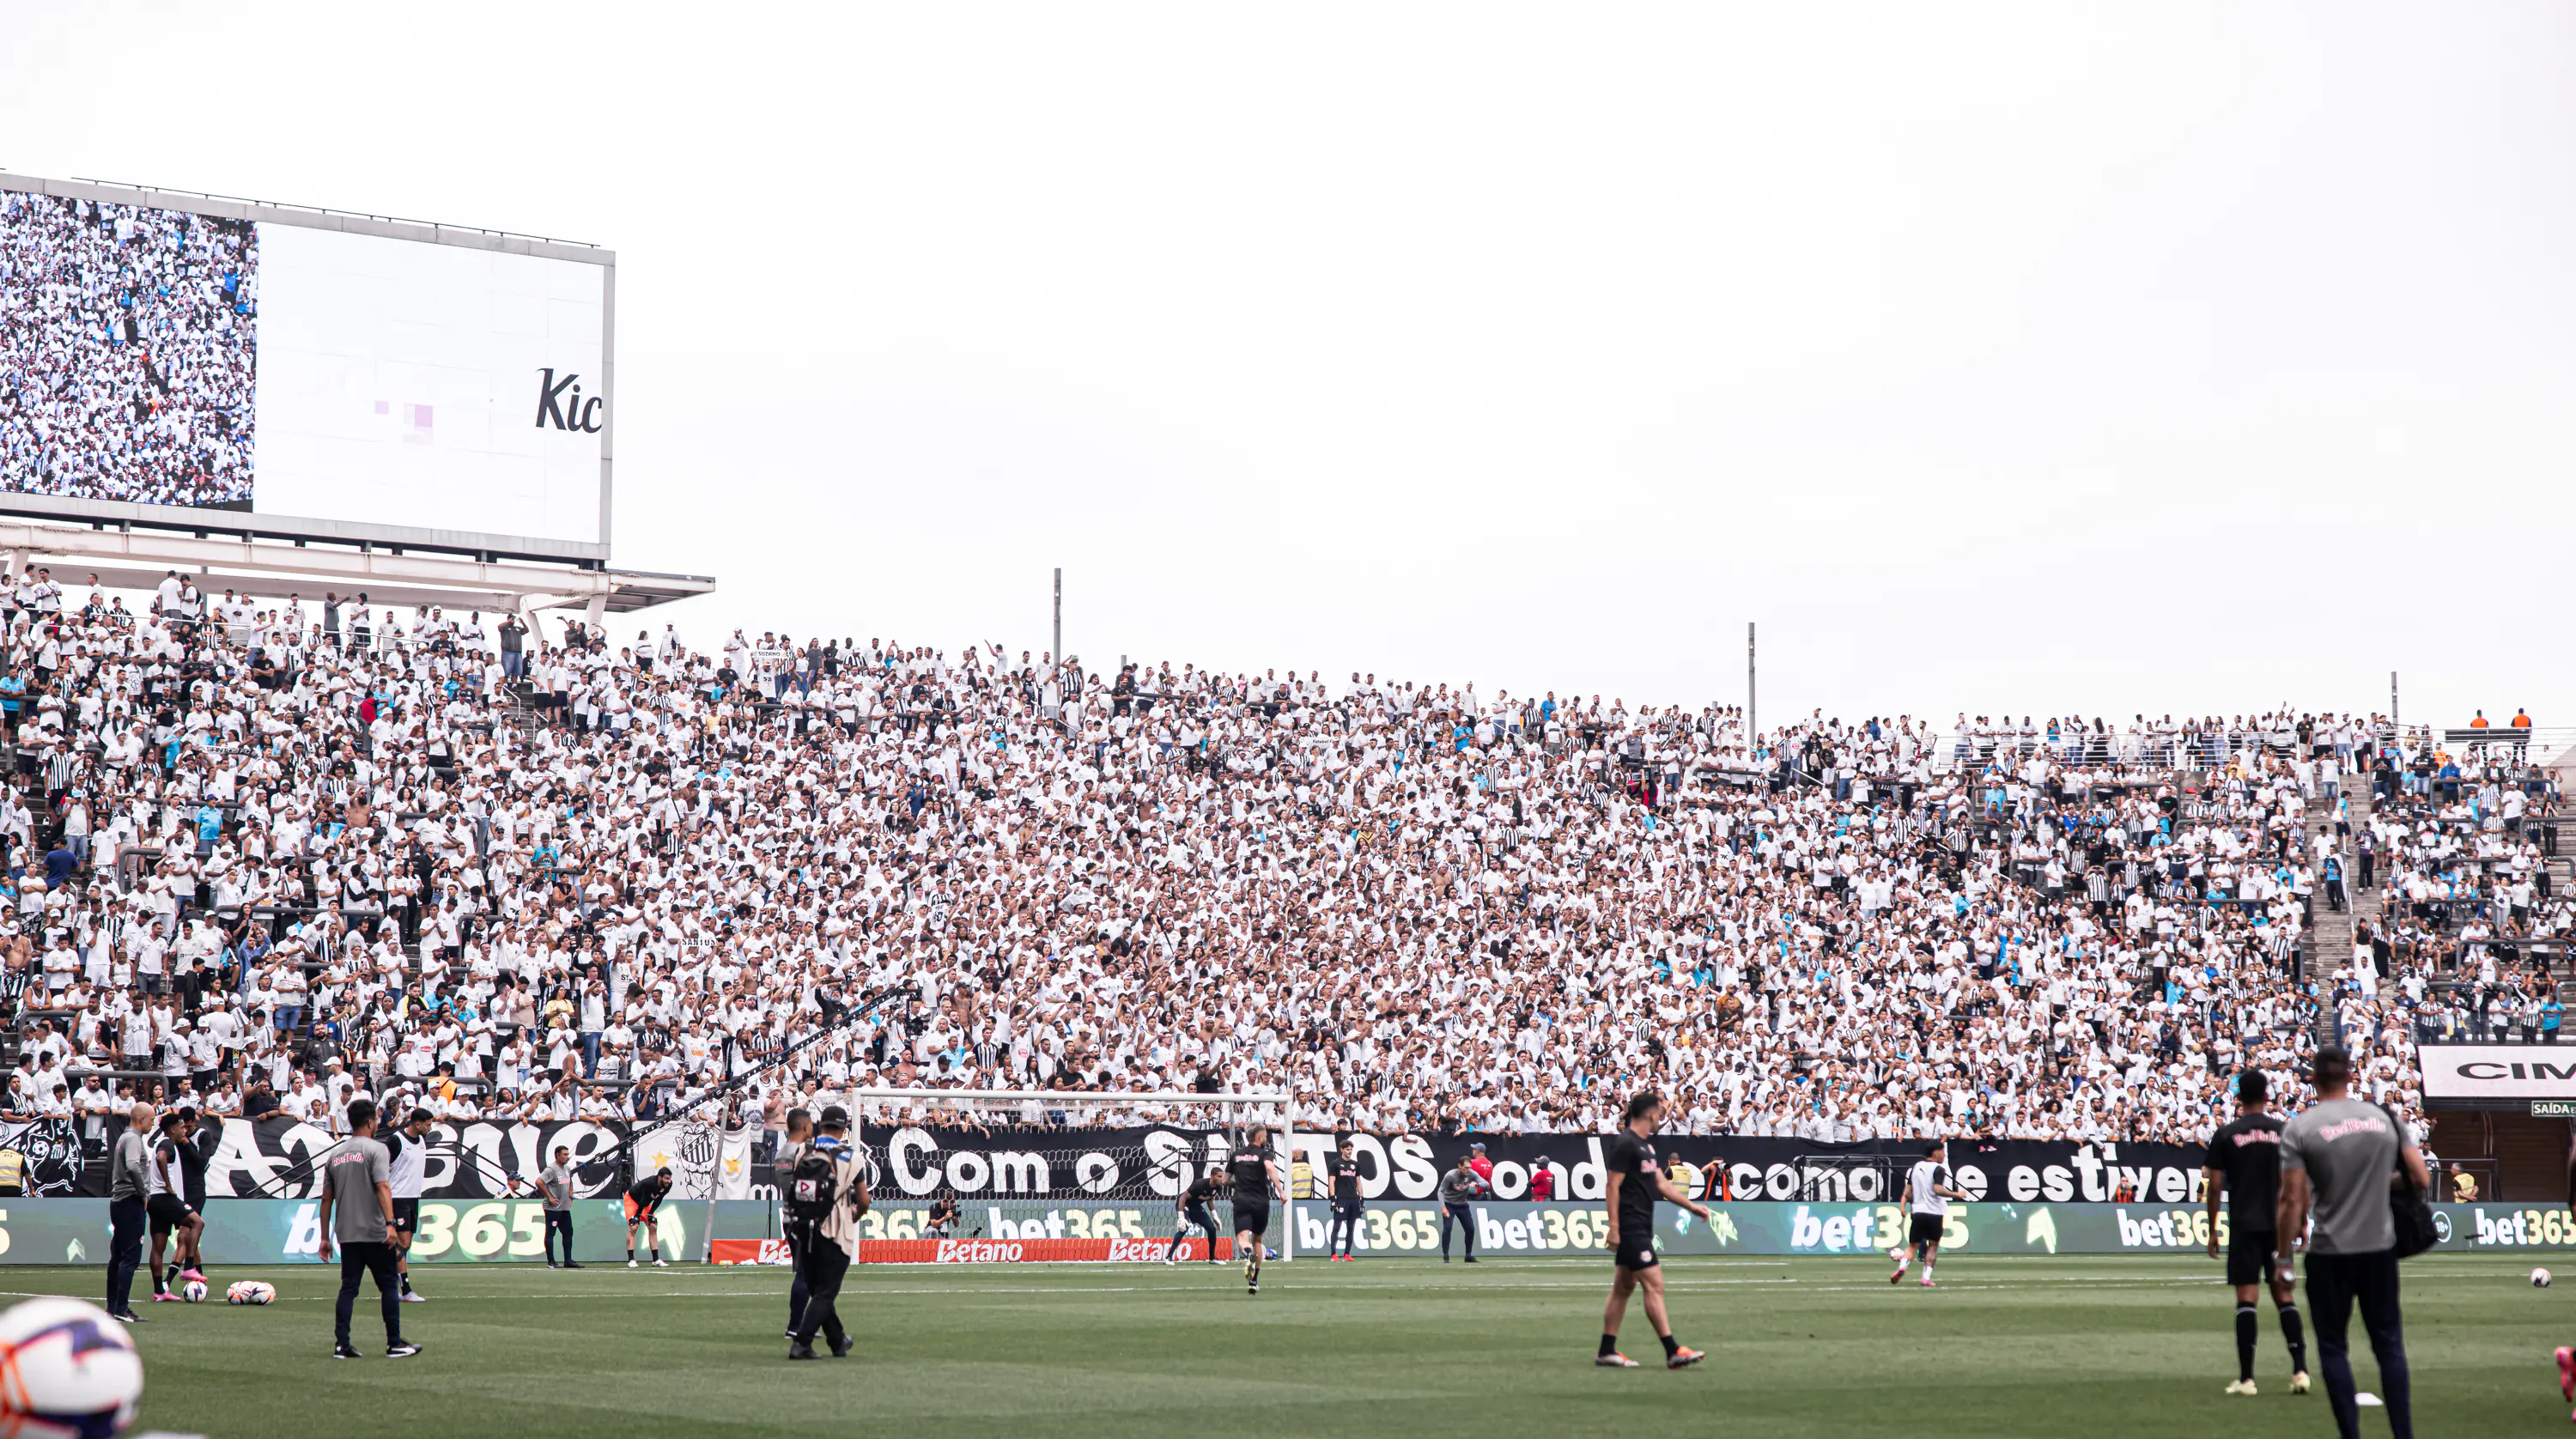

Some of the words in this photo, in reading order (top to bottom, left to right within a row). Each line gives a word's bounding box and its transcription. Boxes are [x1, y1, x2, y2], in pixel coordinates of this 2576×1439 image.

[536, 367, 602, 434] Kic
[2457, 1063, 2576, 1080] CIM
[2534, 1102, 2569, 1114] SAÍDA
[890, 1126, 1050, 1196] Com
[1076, 1152, 1120, 1193] o
[1144, 1129, 1439, 1199] SATOS
[1492, 1137, 1608, 1200] ond
[1730, 1162, 1886, 1201] como
[1905, 1141, 1989, 1202] le
[283, 1203, 546, 1258] b365
[1296, 1207, 1439, 1249] bet365
[1476, 1207, 1610, 1249] bet365
[1791, 1205, 1969, 1249] bet35
[2475, 1207, 2576, 1245] bet365
[936, 1240, 1024, 1263] Betano
